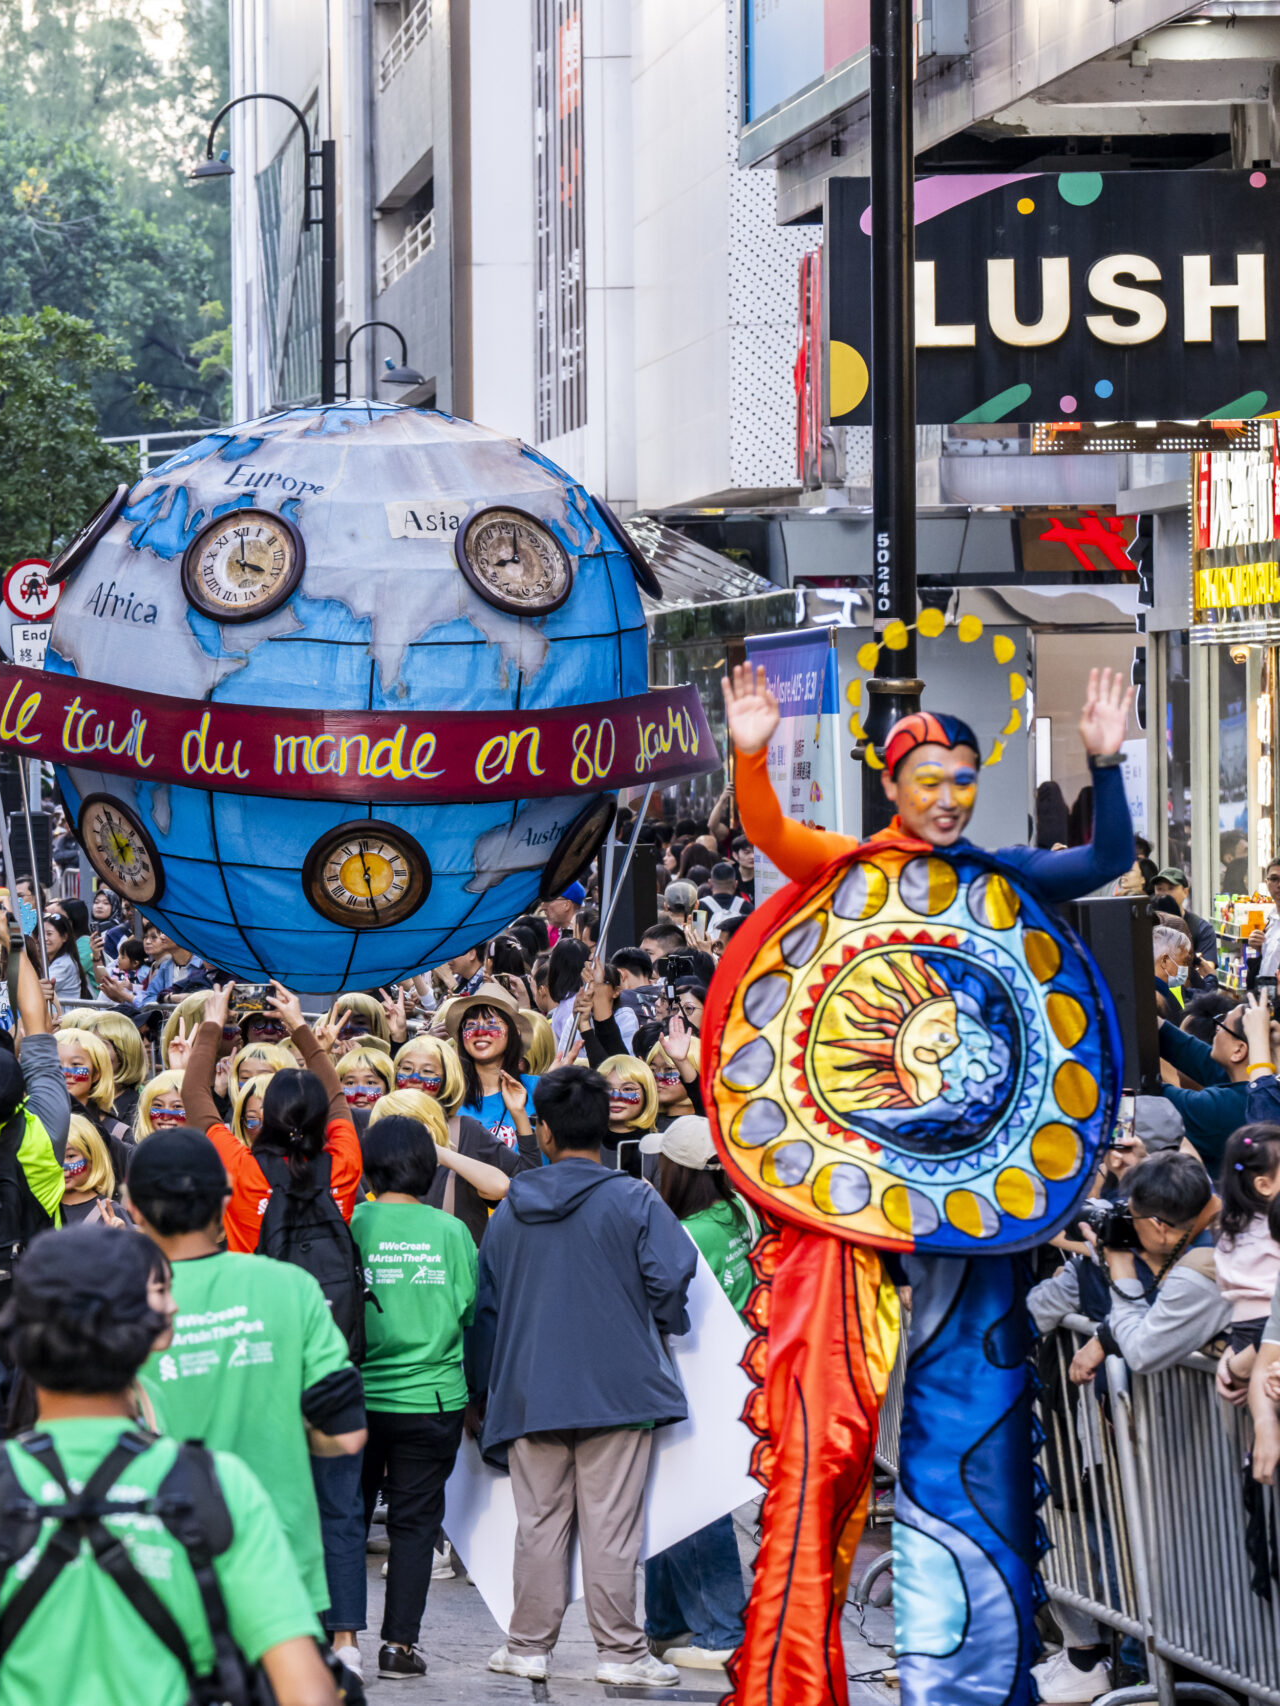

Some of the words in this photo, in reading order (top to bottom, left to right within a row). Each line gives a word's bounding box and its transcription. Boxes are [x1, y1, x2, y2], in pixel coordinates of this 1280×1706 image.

[915, 253, 1267, 347] LUSH
[224, 464, 325, 496] Europe
[404, 510, 460, 532] Asia
[877, 532, 891, 611] 50240
[87, 582, 158, 625] Africa
[22, 630, 47, 641] End
[181, 711, 250, 779] du
[273, 724, 447, 780] monde
[475, 726, 546, 785] en
[571, 718, 616, 786] 80
[634, 705, 699, 774] jours
[368, 1253, 442, 1263] #ArtsInThePark
[378, 1241, 431, 1251] #WeCreate
[172, 1319, 264, 1347] ArtsInThePark
